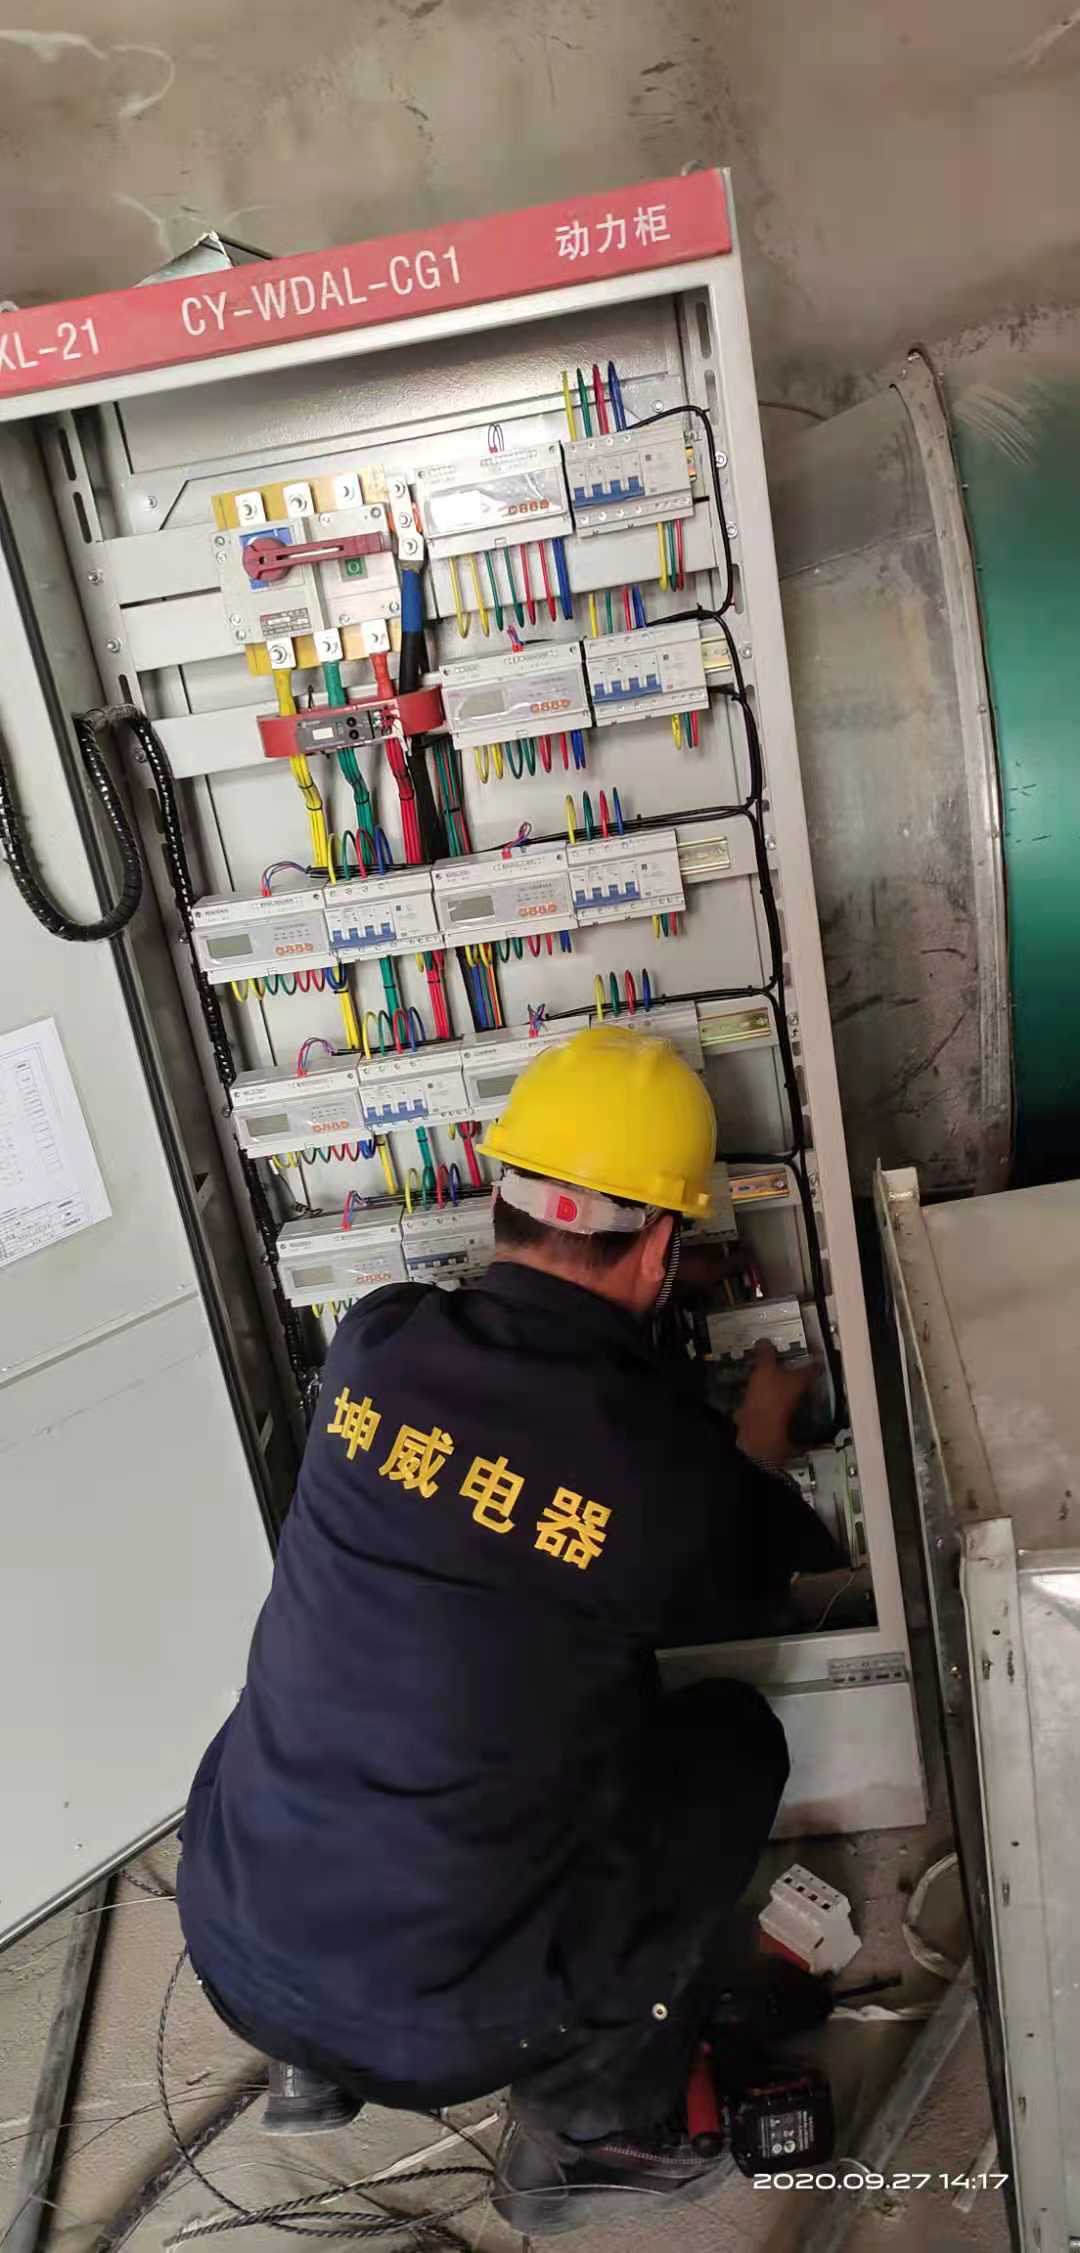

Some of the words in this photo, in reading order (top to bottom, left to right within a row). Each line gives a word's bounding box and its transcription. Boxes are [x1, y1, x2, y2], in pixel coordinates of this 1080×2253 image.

[556, 204, 671, 260] 动力柜
[181, 246, 461, 336] CY-WDAL-CG1
[327, 1386, 612, 1570] 坤威电器
